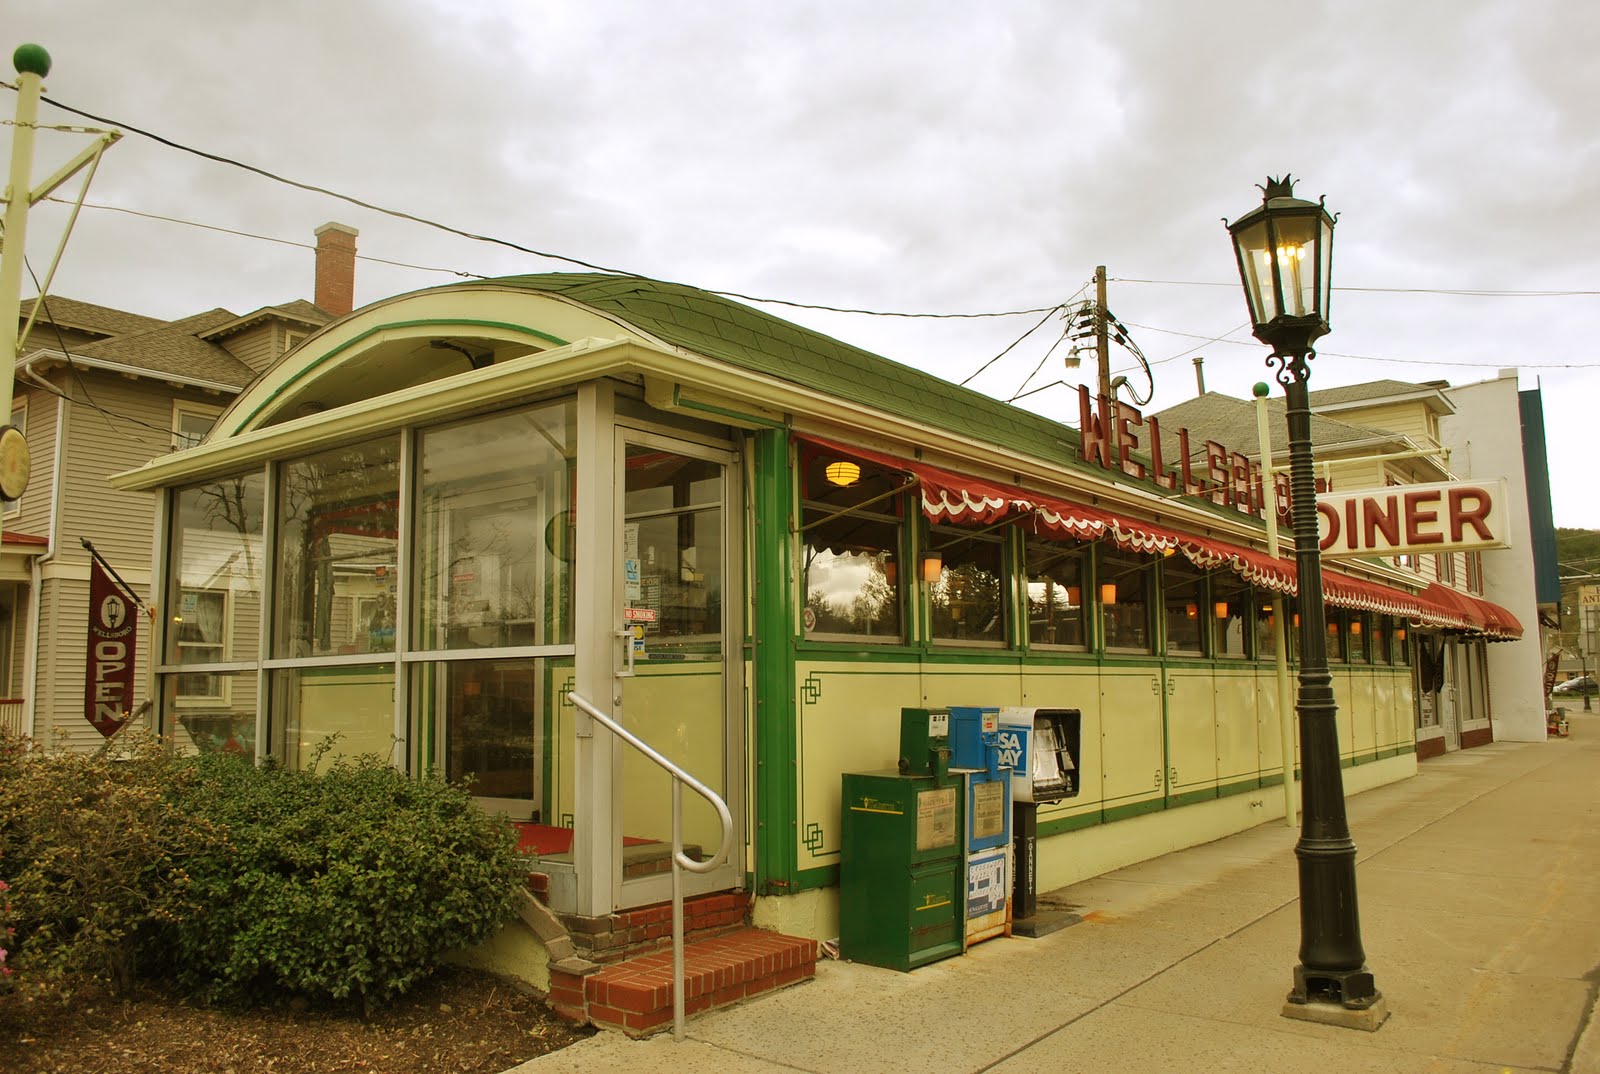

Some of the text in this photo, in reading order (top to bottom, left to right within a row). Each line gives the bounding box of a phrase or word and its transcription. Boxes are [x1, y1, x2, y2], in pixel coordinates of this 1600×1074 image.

[1079, 383, 1294, 529] WELLSBR
[1316, 486, 1494, 551] DINER
[93, 625, 133, 639] WELLSBORO
[632, 610, 654, 620] SMOKING
[93, 641, 127, 723] OPEN
[998, 732, 1021, 750] SA
